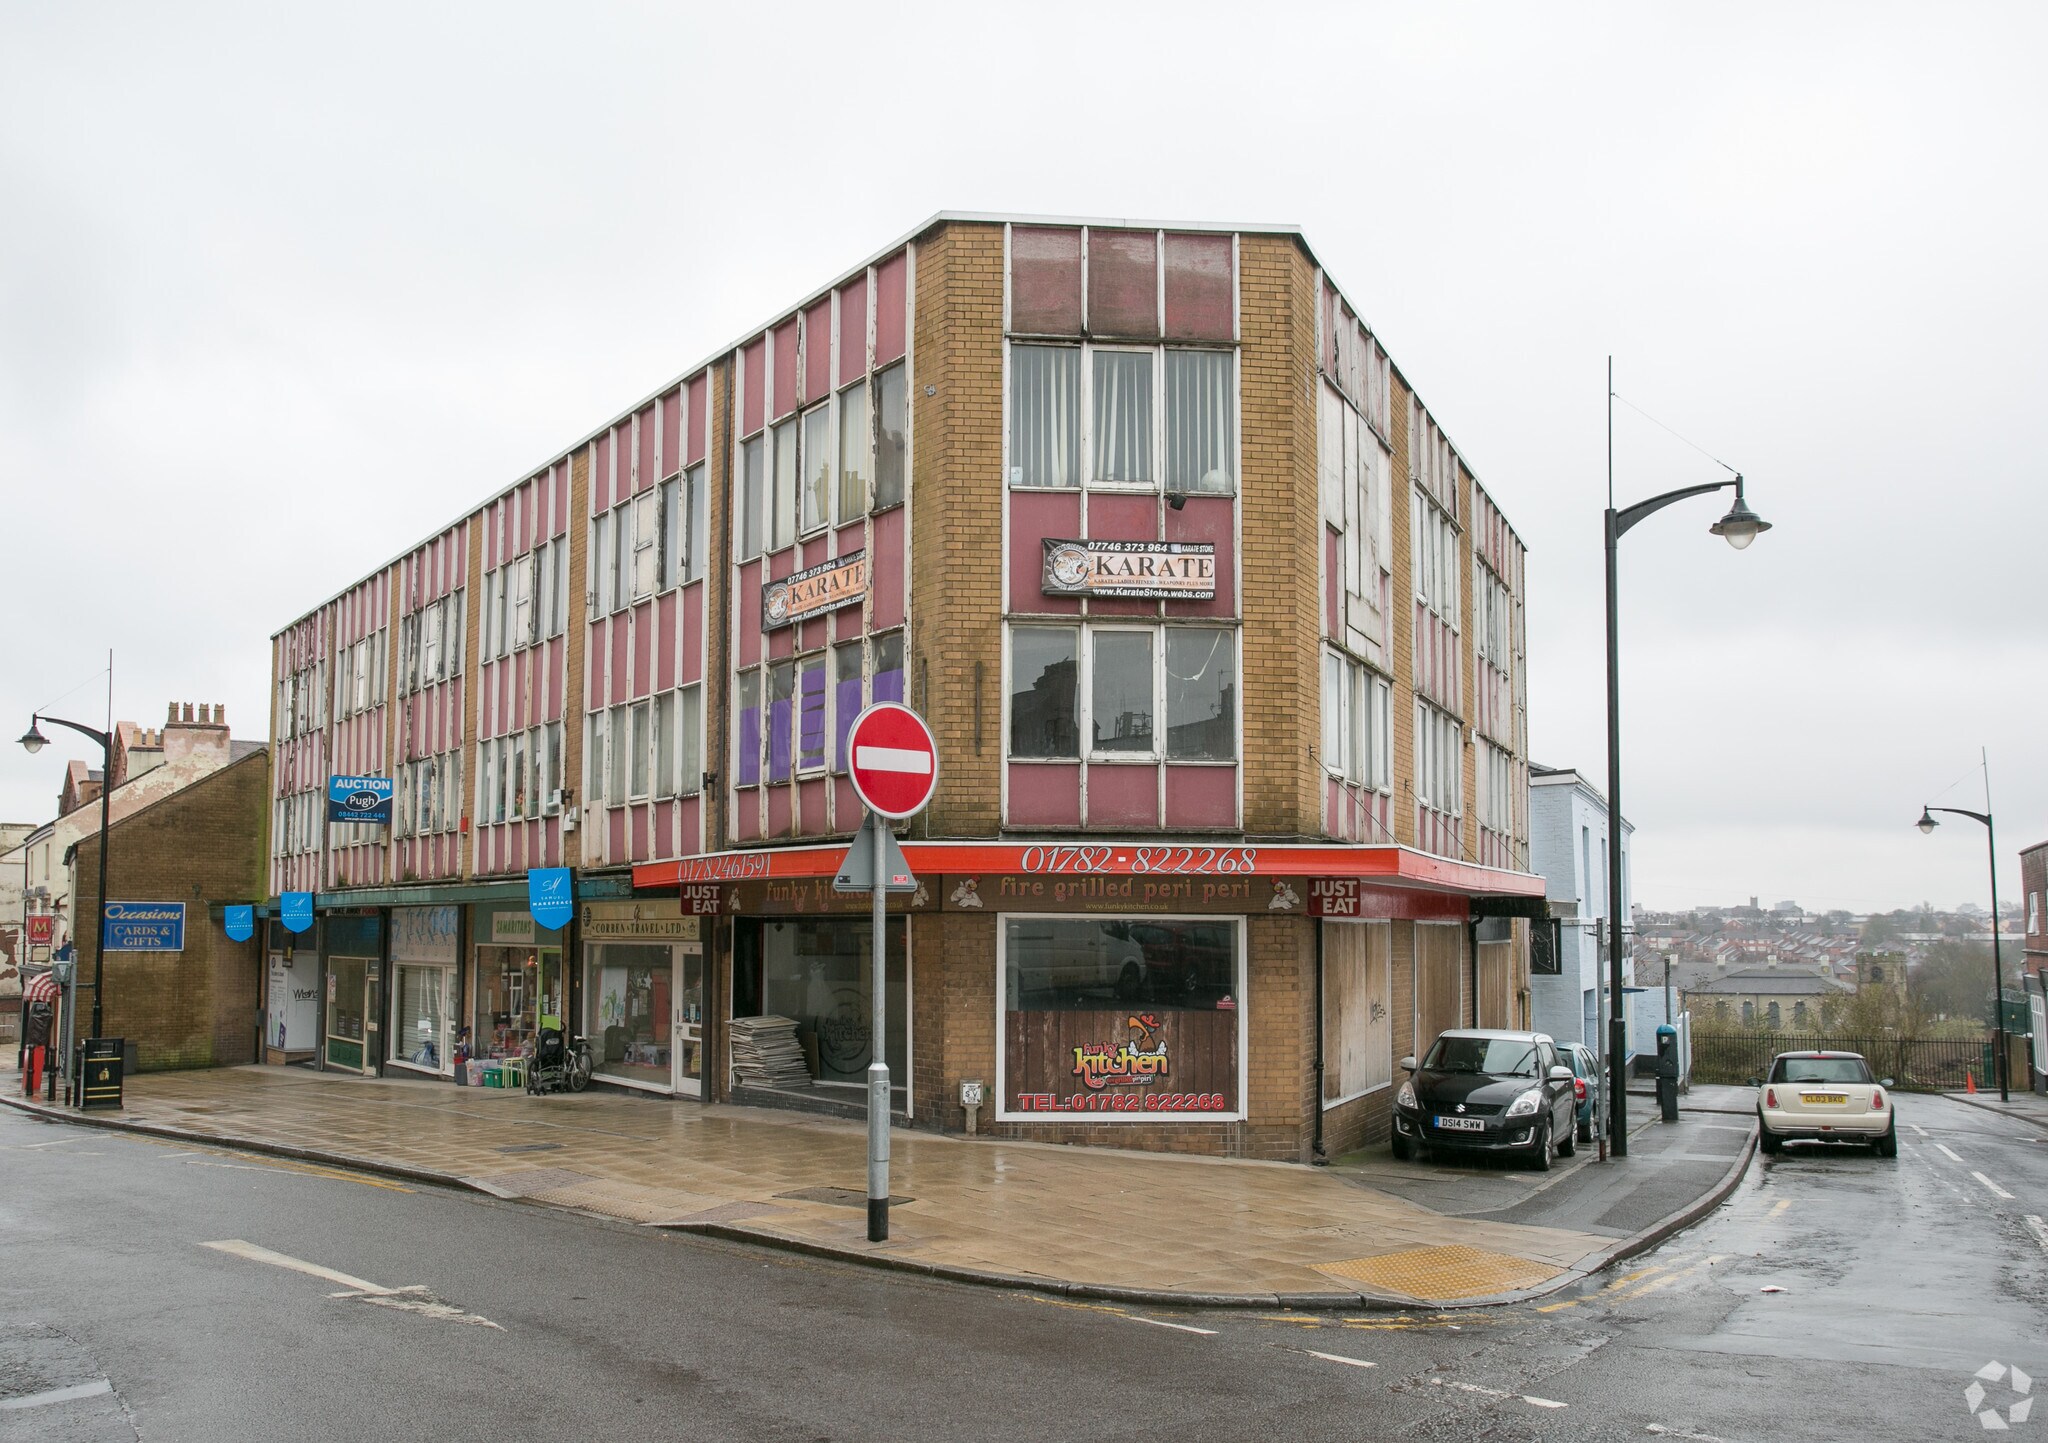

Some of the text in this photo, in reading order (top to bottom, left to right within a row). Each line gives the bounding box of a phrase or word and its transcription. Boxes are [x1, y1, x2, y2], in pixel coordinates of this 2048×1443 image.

[1088, 542, 1121, 551] 07746
[1124, 543, 1145, 552] 373
[1147, 543, 1168, 553] 964
[787, 572, 807, 585] 07746
[808, 566, 821, 577] 373
[822, 562, 836, 573] 964
[1095, 555, 1214, 578] KARATE
[791, 564, 865, 604] KARATE
[1093, 587, 1214, 598] www.KarateStoke.webs.com
[335, 778, 390, 790] AUCTION
[350, 795, 375, 808] Pugh
[678, 853, 771, 882] 01782461591
[683, 885, 720, 899] JUST
[766, 880, 808, 911] funky
[1000, 877, 1250, 903] fire grilled peri peri
[1311, 880, 1358, 897] JUST
[105, 905, 182, 920] Occasions
[692, 900, 720, 913] EAT
[1085, 902, 1168, 911] www.funkykitchen.co.uk
[1322, 897, 1358, 914] EAT
[33, 920, 48, 933] M
[114, 926, 171, 936] CARDS &
[595, 923, 625, 934] CORBEN
[630, 923, 660, 934] TRAVEL
[665, 923, 681, 933] LTD
[123, 937, 161, 946] GIFTS
[1083, 1041, 1119, 1058] funky
[1073, 1048, 1168, 1088] kitchen
[1145, 1093, 1225, 1111] 822268
[1805, 1095, 1843, 1103] CL03 BXO
[1442, 1118, 1481, 1129] DS14 SWW
